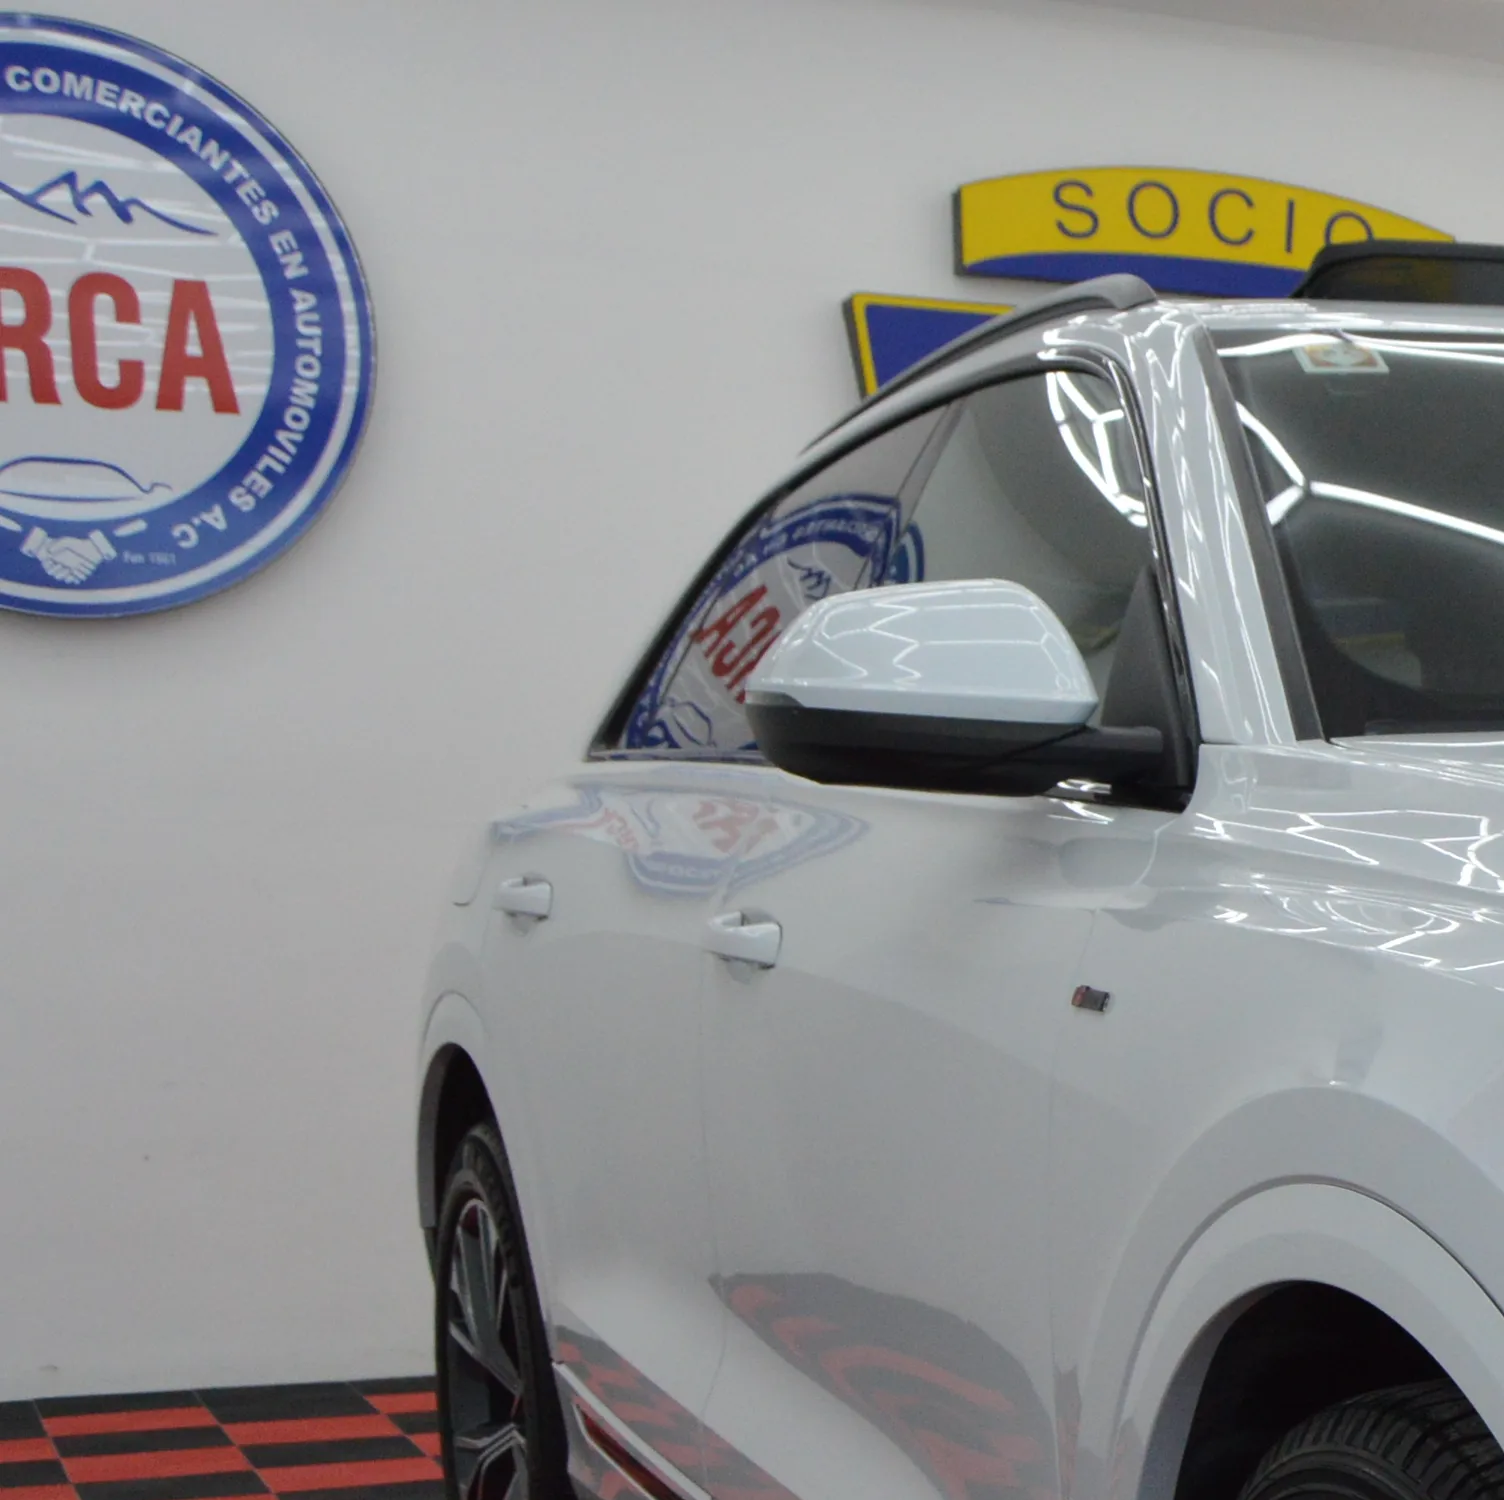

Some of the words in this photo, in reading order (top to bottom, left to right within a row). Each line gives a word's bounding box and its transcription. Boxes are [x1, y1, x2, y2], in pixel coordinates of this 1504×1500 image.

[4, 64, 279, 226] COMERCIANTES
[269, 228, 307, 281] EN
[226, 289, 324, 513] AUTOMOVILES
